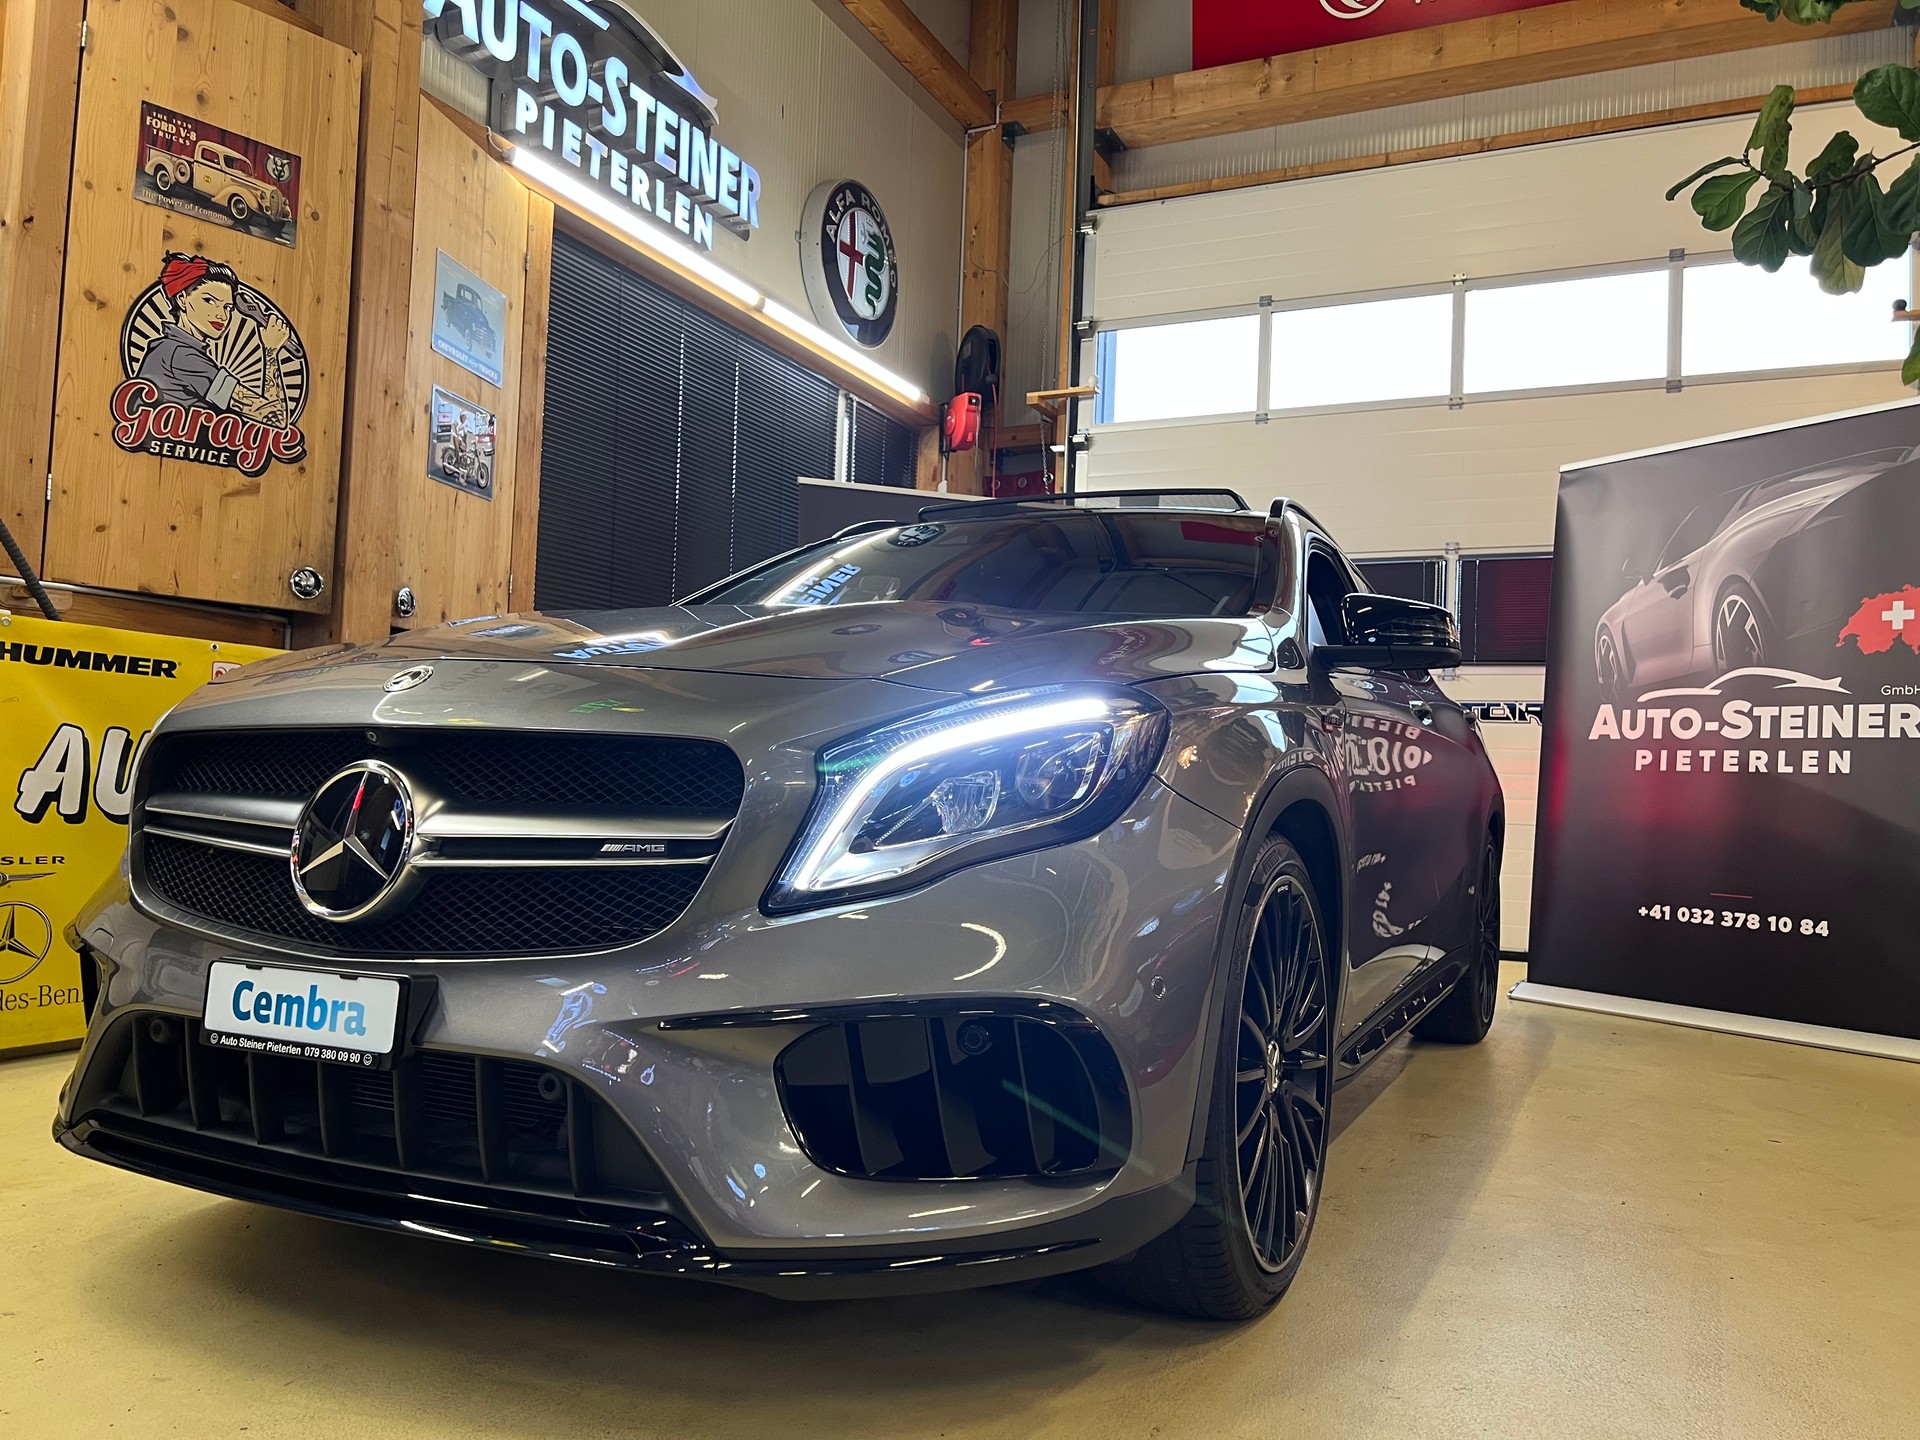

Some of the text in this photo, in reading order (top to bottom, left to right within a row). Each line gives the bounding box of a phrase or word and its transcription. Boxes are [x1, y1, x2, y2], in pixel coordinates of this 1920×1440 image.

[146, 116, 197, 141] FORD V-8
[152, 111, 167, 121] THE
[153, 129, 190, 146] TRUCKS
[515, 88, 713, 251] PIETERLEN
[142, 189, 230, 222] The Power of Economy
[826, 189, 897, 288] ALFA ROMEO
[113, 379, 303, 471] Garage
[150, 441, 230, 465] SERVICE
[0, 641, 178, 679] HUMMER
[1588, 700, 1920, 740] AUTO-STEINER
[1635, 749, 1851, 774] PIETERLEN
[0, 856, 66, 865] SLER
[621, 844, 665, 852] AMG
[1638, 904, 1830, 937] +41 032 378 10 84
[0, 984, 84, 1012] es-Ben
[232, 980, 367, 1036] Cembra
[220, 1035, 361, 1064] Auto Steiner Pieterlen 079 380 09 90
